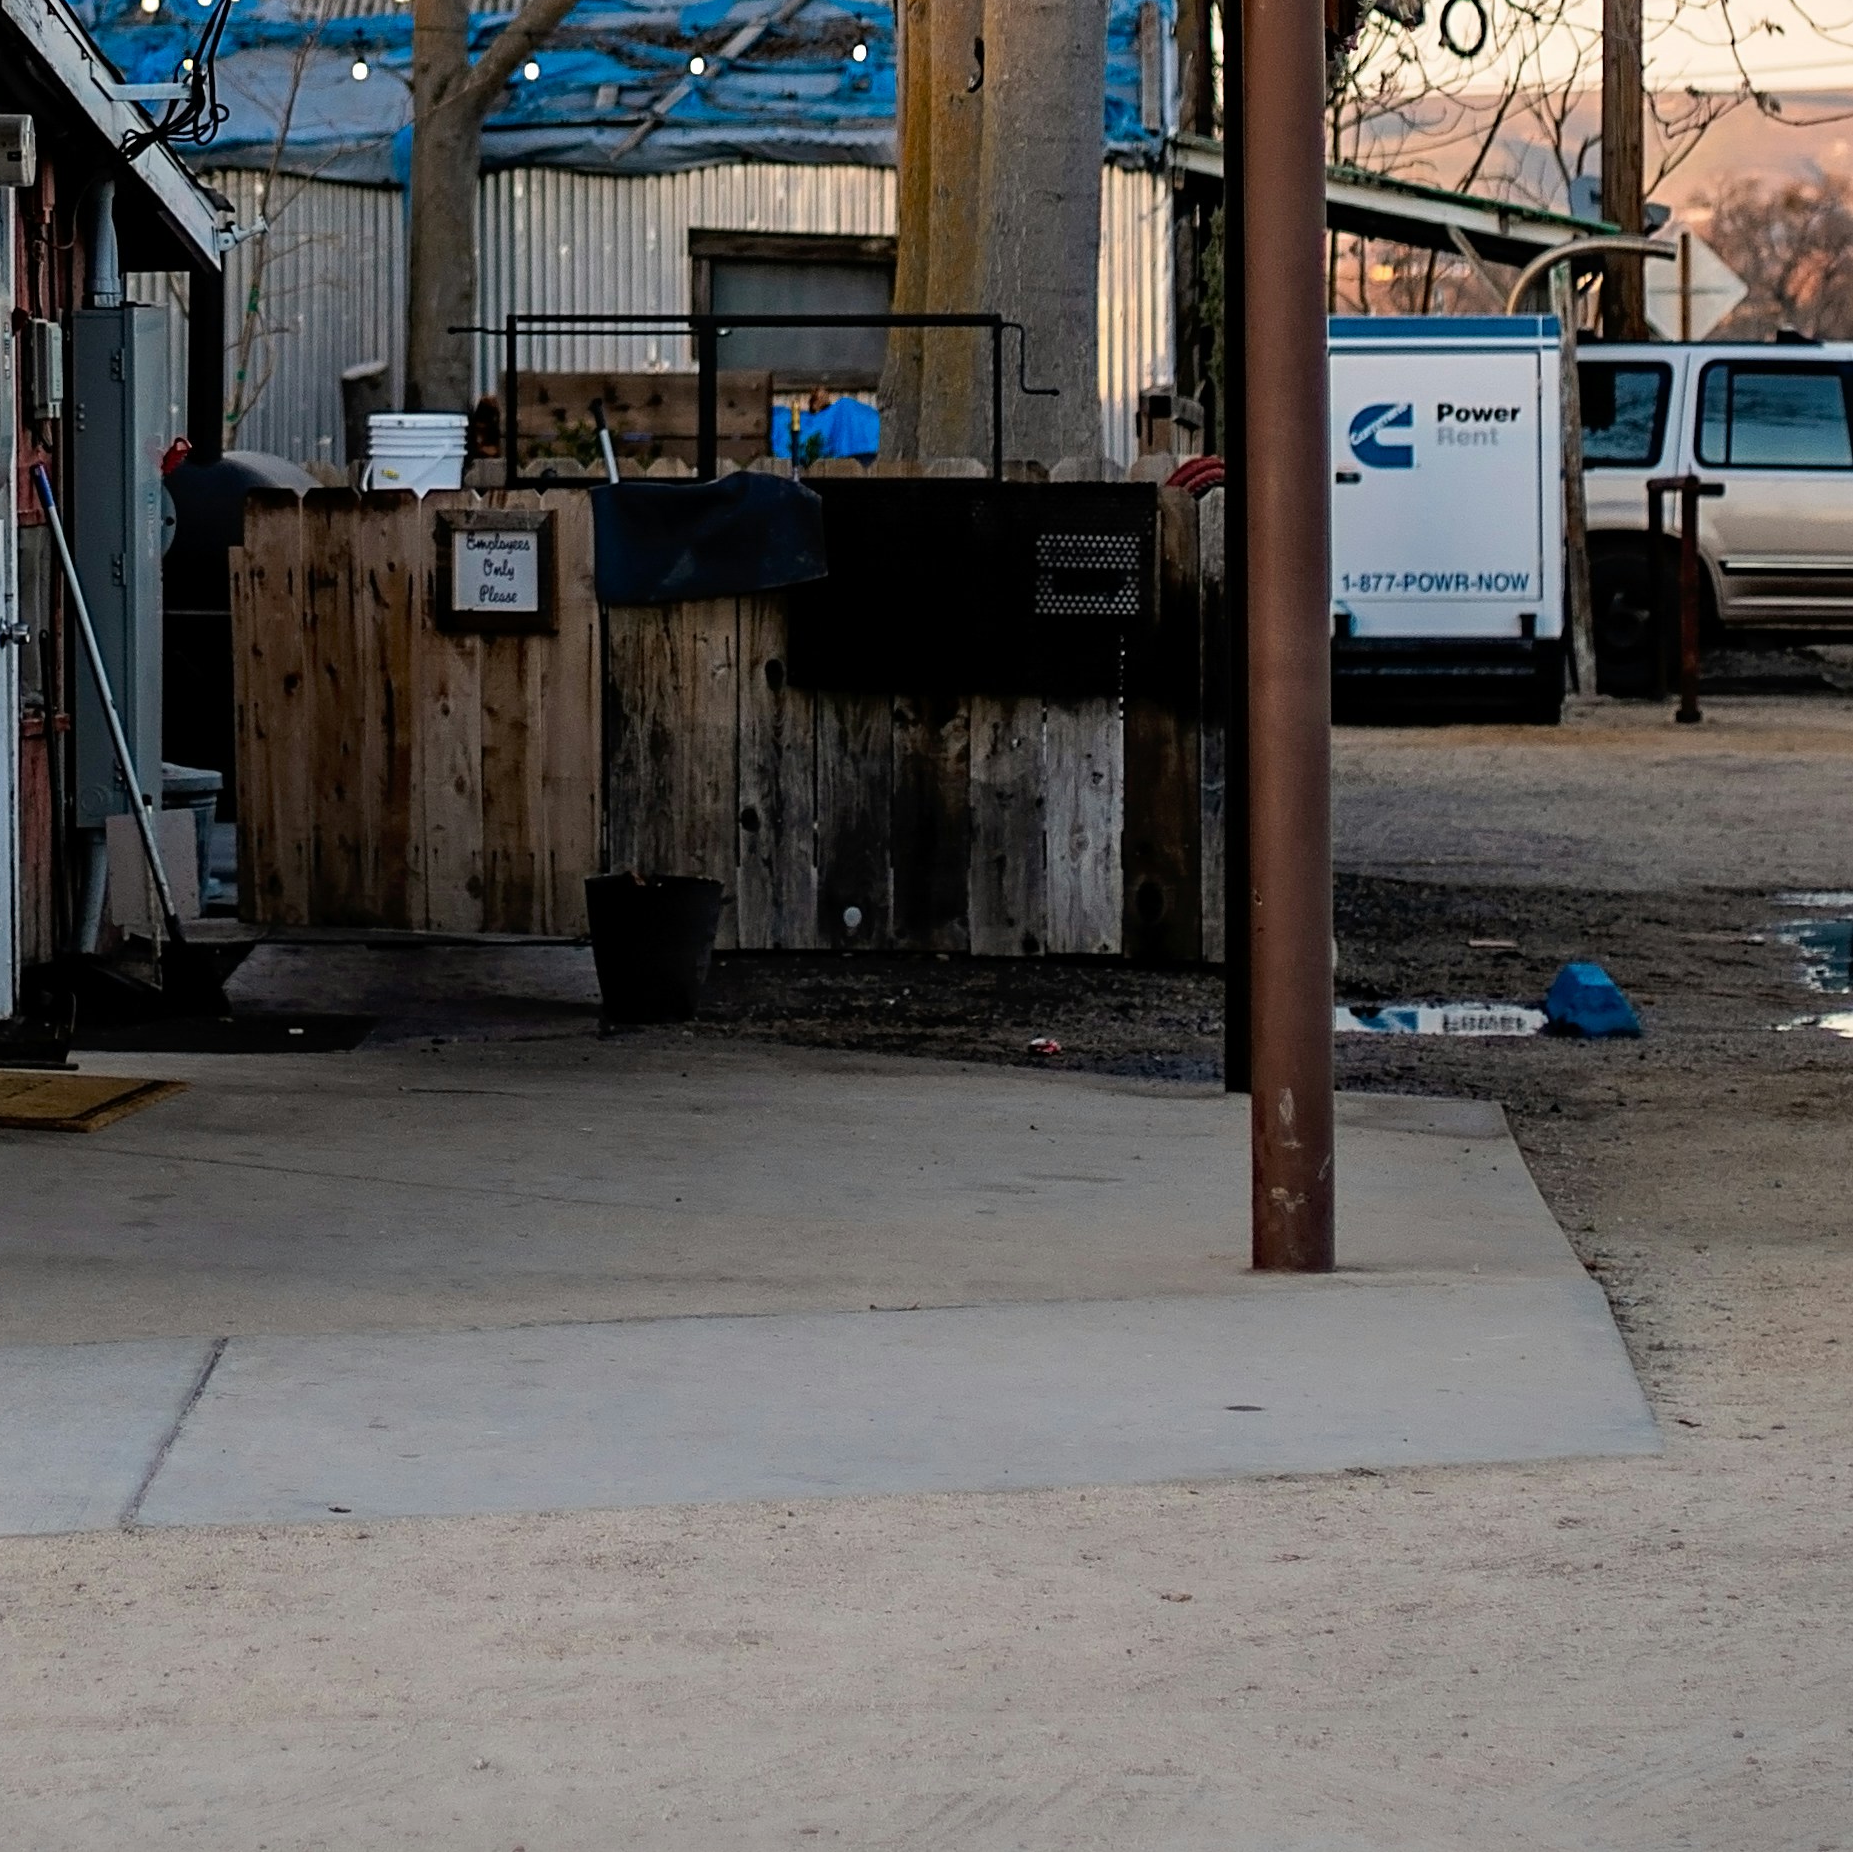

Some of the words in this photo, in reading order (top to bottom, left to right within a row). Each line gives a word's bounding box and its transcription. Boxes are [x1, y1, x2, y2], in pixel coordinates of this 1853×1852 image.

[1437, 402, 1521, 423] Power
[1437, 426, 1500, 446] Rent
[466, 531, 531, 555] Employees
[483, 558, 515, 581] Only
[1341, 571, 1530, 593] 1-877-POWR-NOW
[479, 584, 519, 604] Please
